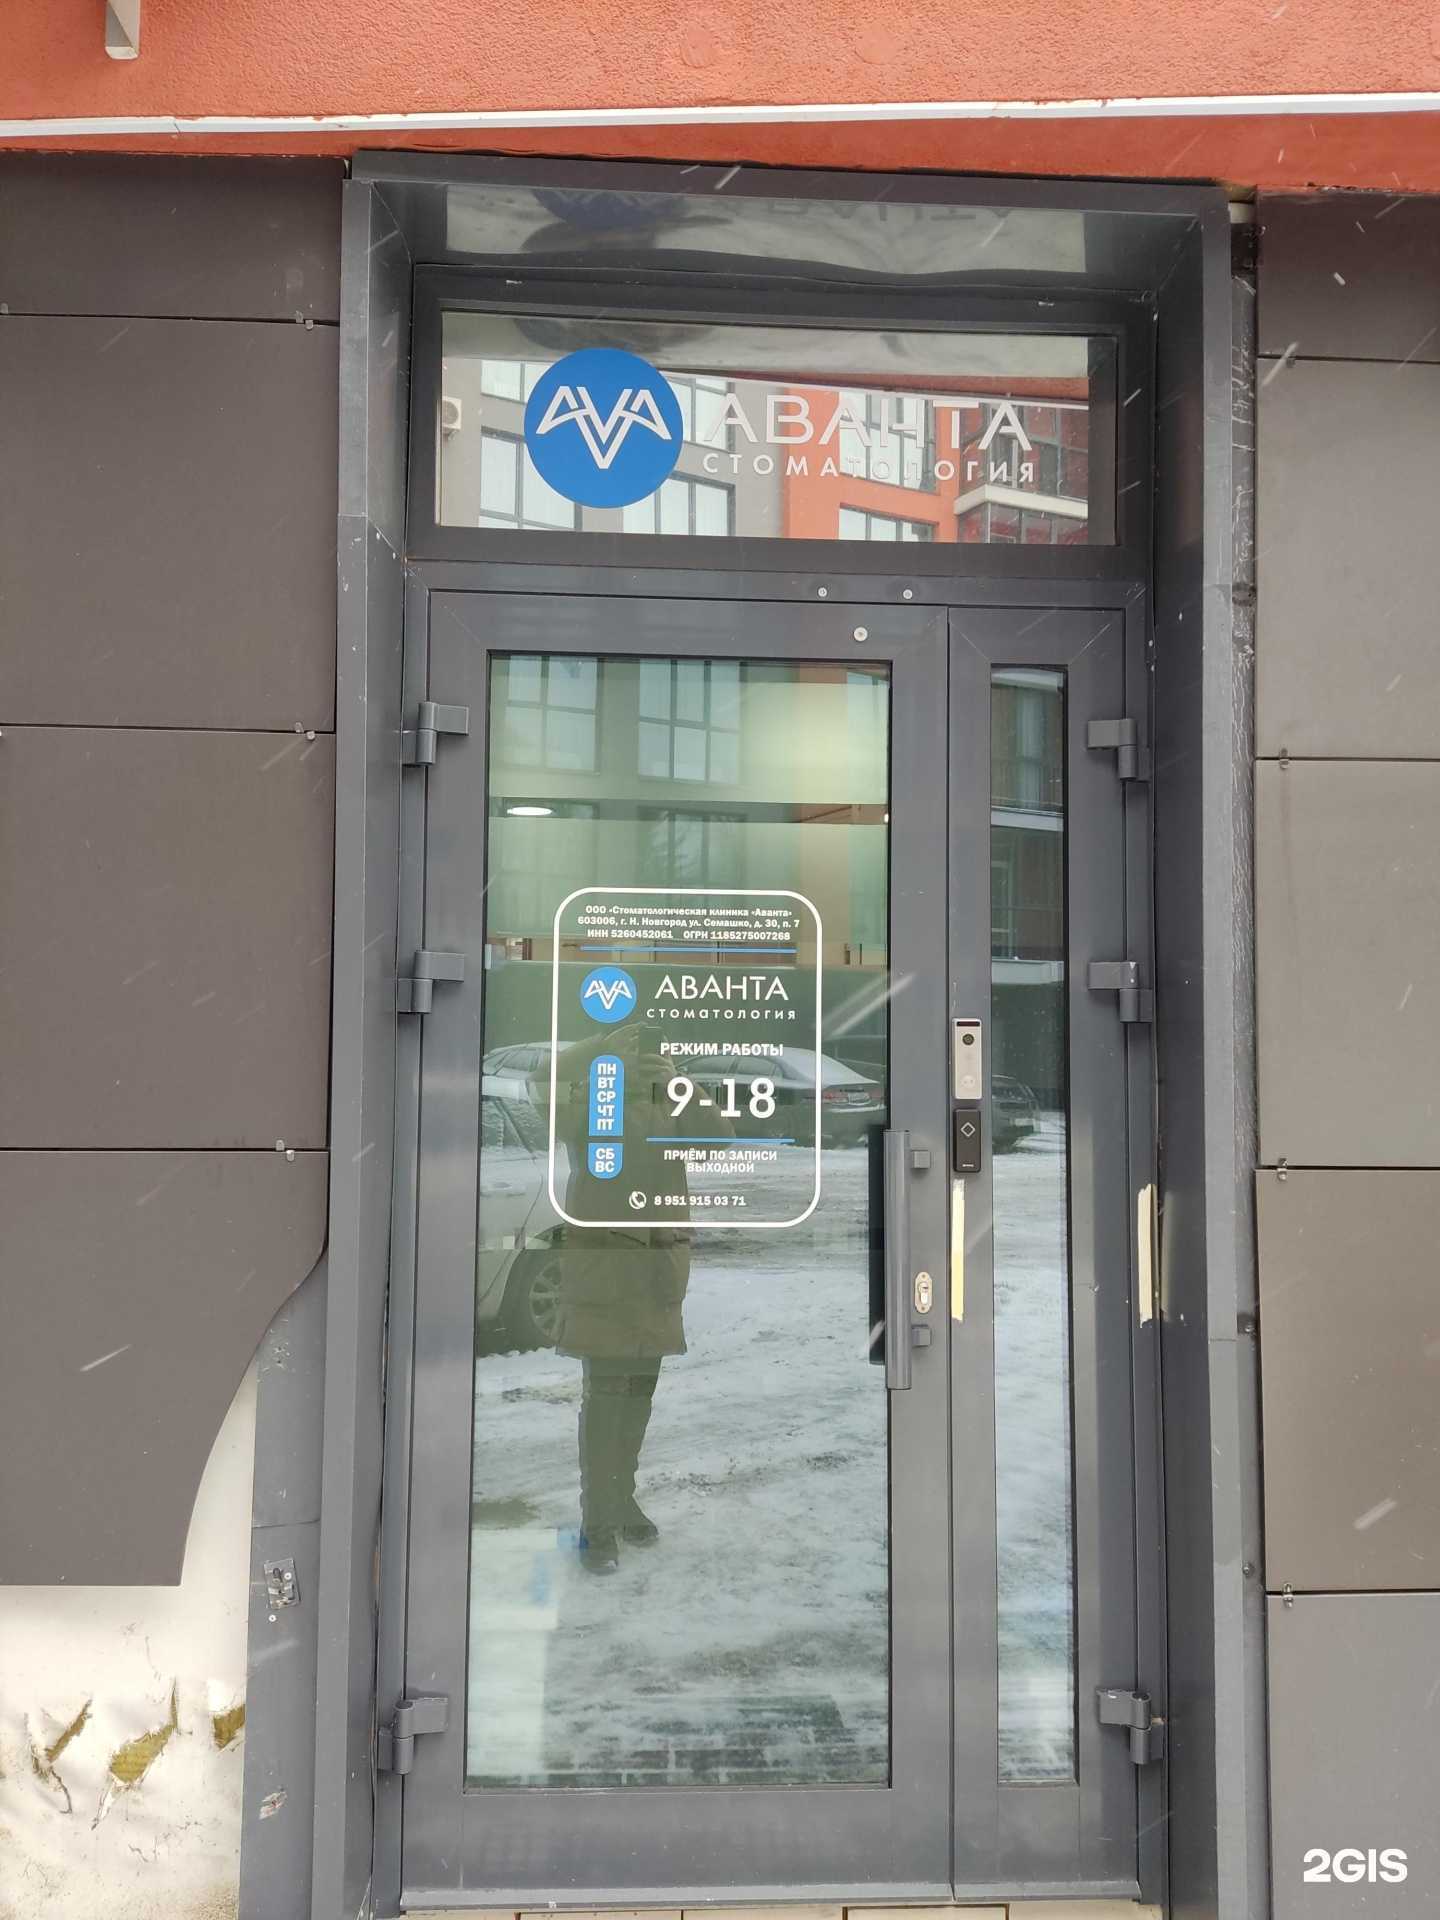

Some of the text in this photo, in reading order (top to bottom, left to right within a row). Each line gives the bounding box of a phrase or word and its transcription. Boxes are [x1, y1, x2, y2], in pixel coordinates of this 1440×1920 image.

[703, 392, 1033, 451] АВАНТА
[585, 905, 606, 914] ООО
[709, 908, 749, 917] клиника
[577, 916, 618, 926] 603006,
[629, 917, 640, 926] Н.
[641, 917, 687, 928] Новгород
[764, 919, 781, 929] 30,
[793, 919, 800, 928] 7
[587, 929, 608, 938] ИНН
[683, 930, 708, 939] ОГРН
[654, 974, 789, 1001] АВАНТА
[660, 1042, 784, 1057] РЕЖИМ РАБОТЫ
[597, 1063, 617, 1075] ПН
[597, 1077, 616, 1089] ВТ
[596, 1091, 616, 1103] СР
[666, 1076, 776, 1119] 9-18
[597, 1104, 615, 1117] ЧТ
[597, 1118, 615, 1131] ПТ
[595, 1148, 616, 1160] СБ
[664, 1148, 778, 1161] ПРИЁМ ПО ЗАПИСИ
[595, 1161, 615, 1173] ВС
[686, 1161, 755, 1174] ВЫХОДНОЙ
[654, 1195, 746, 1206] 8 951 915 03 71
